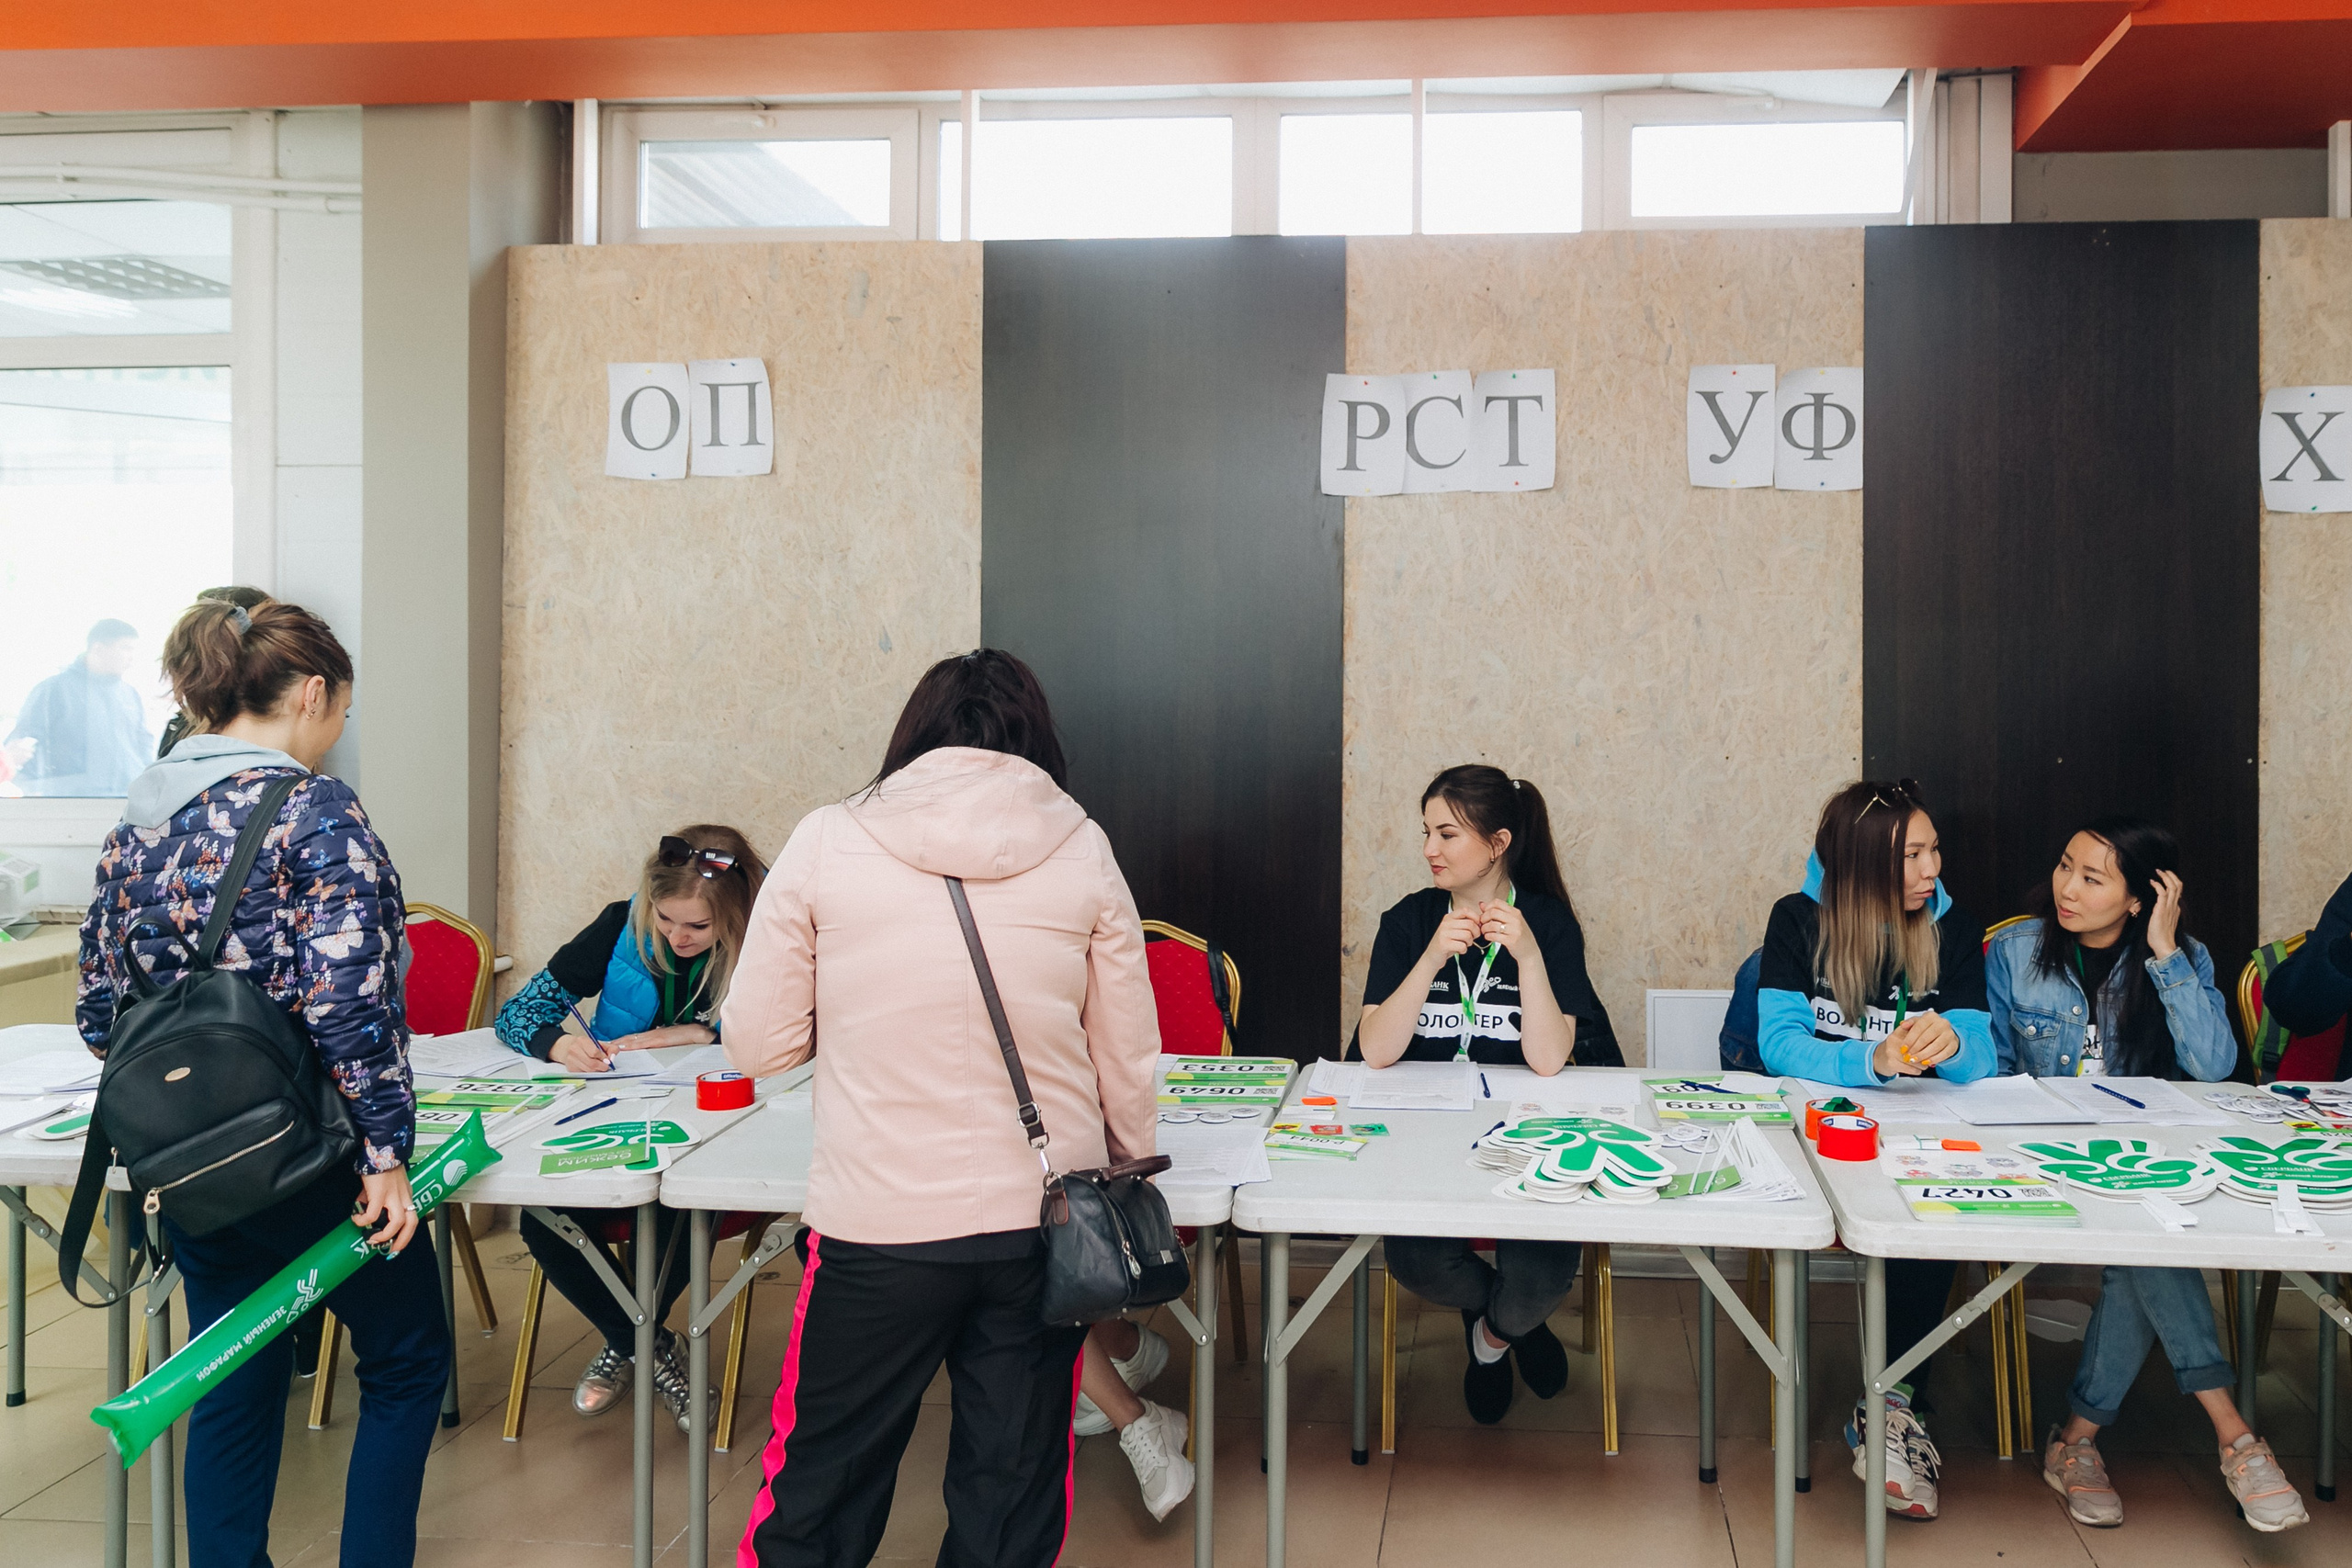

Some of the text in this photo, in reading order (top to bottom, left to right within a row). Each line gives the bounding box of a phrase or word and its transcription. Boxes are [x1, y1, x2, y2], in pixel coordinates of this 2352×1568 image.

[2268, 411, 2346, 482] Х
[1417, 1011, 1504, 1030] ОЛОТЕР
[1182, 1064, 1255, 1072] 0353
[451, 1083, 533, 1092] 0326
[1169, 1087, 1246, 1095] 0649
[1666, 1101, 1747, 1111] 0399
[1922, 1187, 2014, 1199] 0427
[196, 1304, 288, 1382] ЗЕЛЕНЫЙ МАРАФОН
